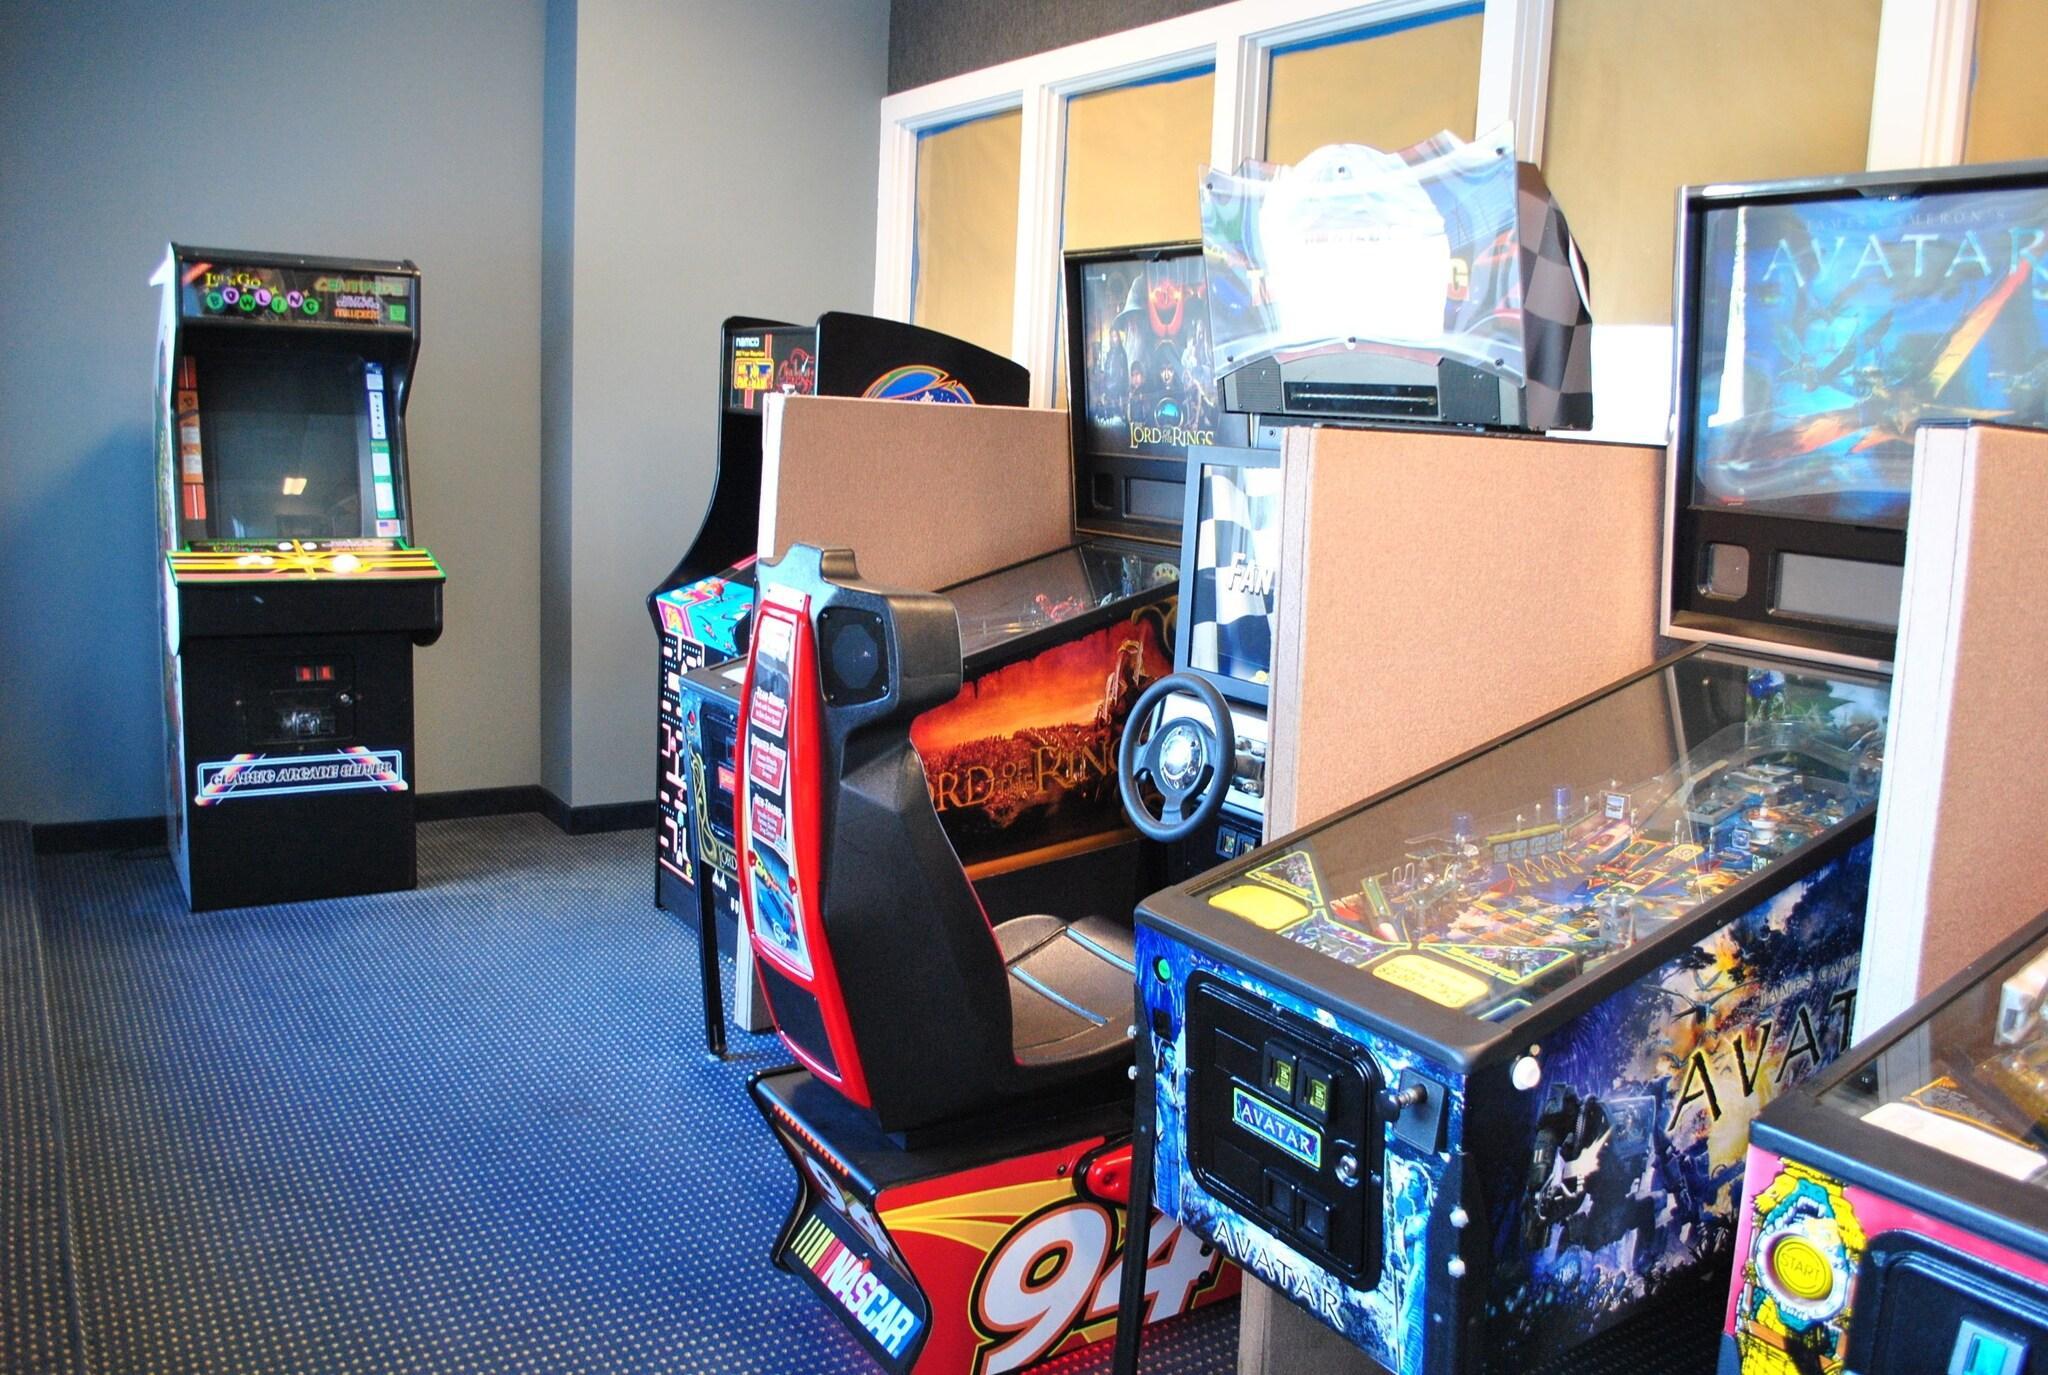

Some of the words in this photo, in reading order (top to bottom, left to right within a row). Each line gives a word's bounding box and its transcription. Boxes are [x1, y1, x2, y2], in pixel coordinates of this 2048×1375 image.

[1762, 226, 2048, 288] AVATAR
[206, 287, 319, 315] BOWLING
[1129, 422, 1162, 449] LORD
[1172, 425, 1214, 447] RINGS
[1229, 552, 1275, 596] FAN
[211, 769, 276, 786] CLASSIC
[276, 764, 340, 783] ARCADE
[929, 767, 995, 812] RD
[1666, 987, 1858, 1133] AVAT
[1241, 1103, 1312, 1156] AVATAR
[1213, 1220, 1346, 1329] AVATAR
[1780, 1250, 1823, 1282] START
[822, 1248, 917, 1360] NASCAR
